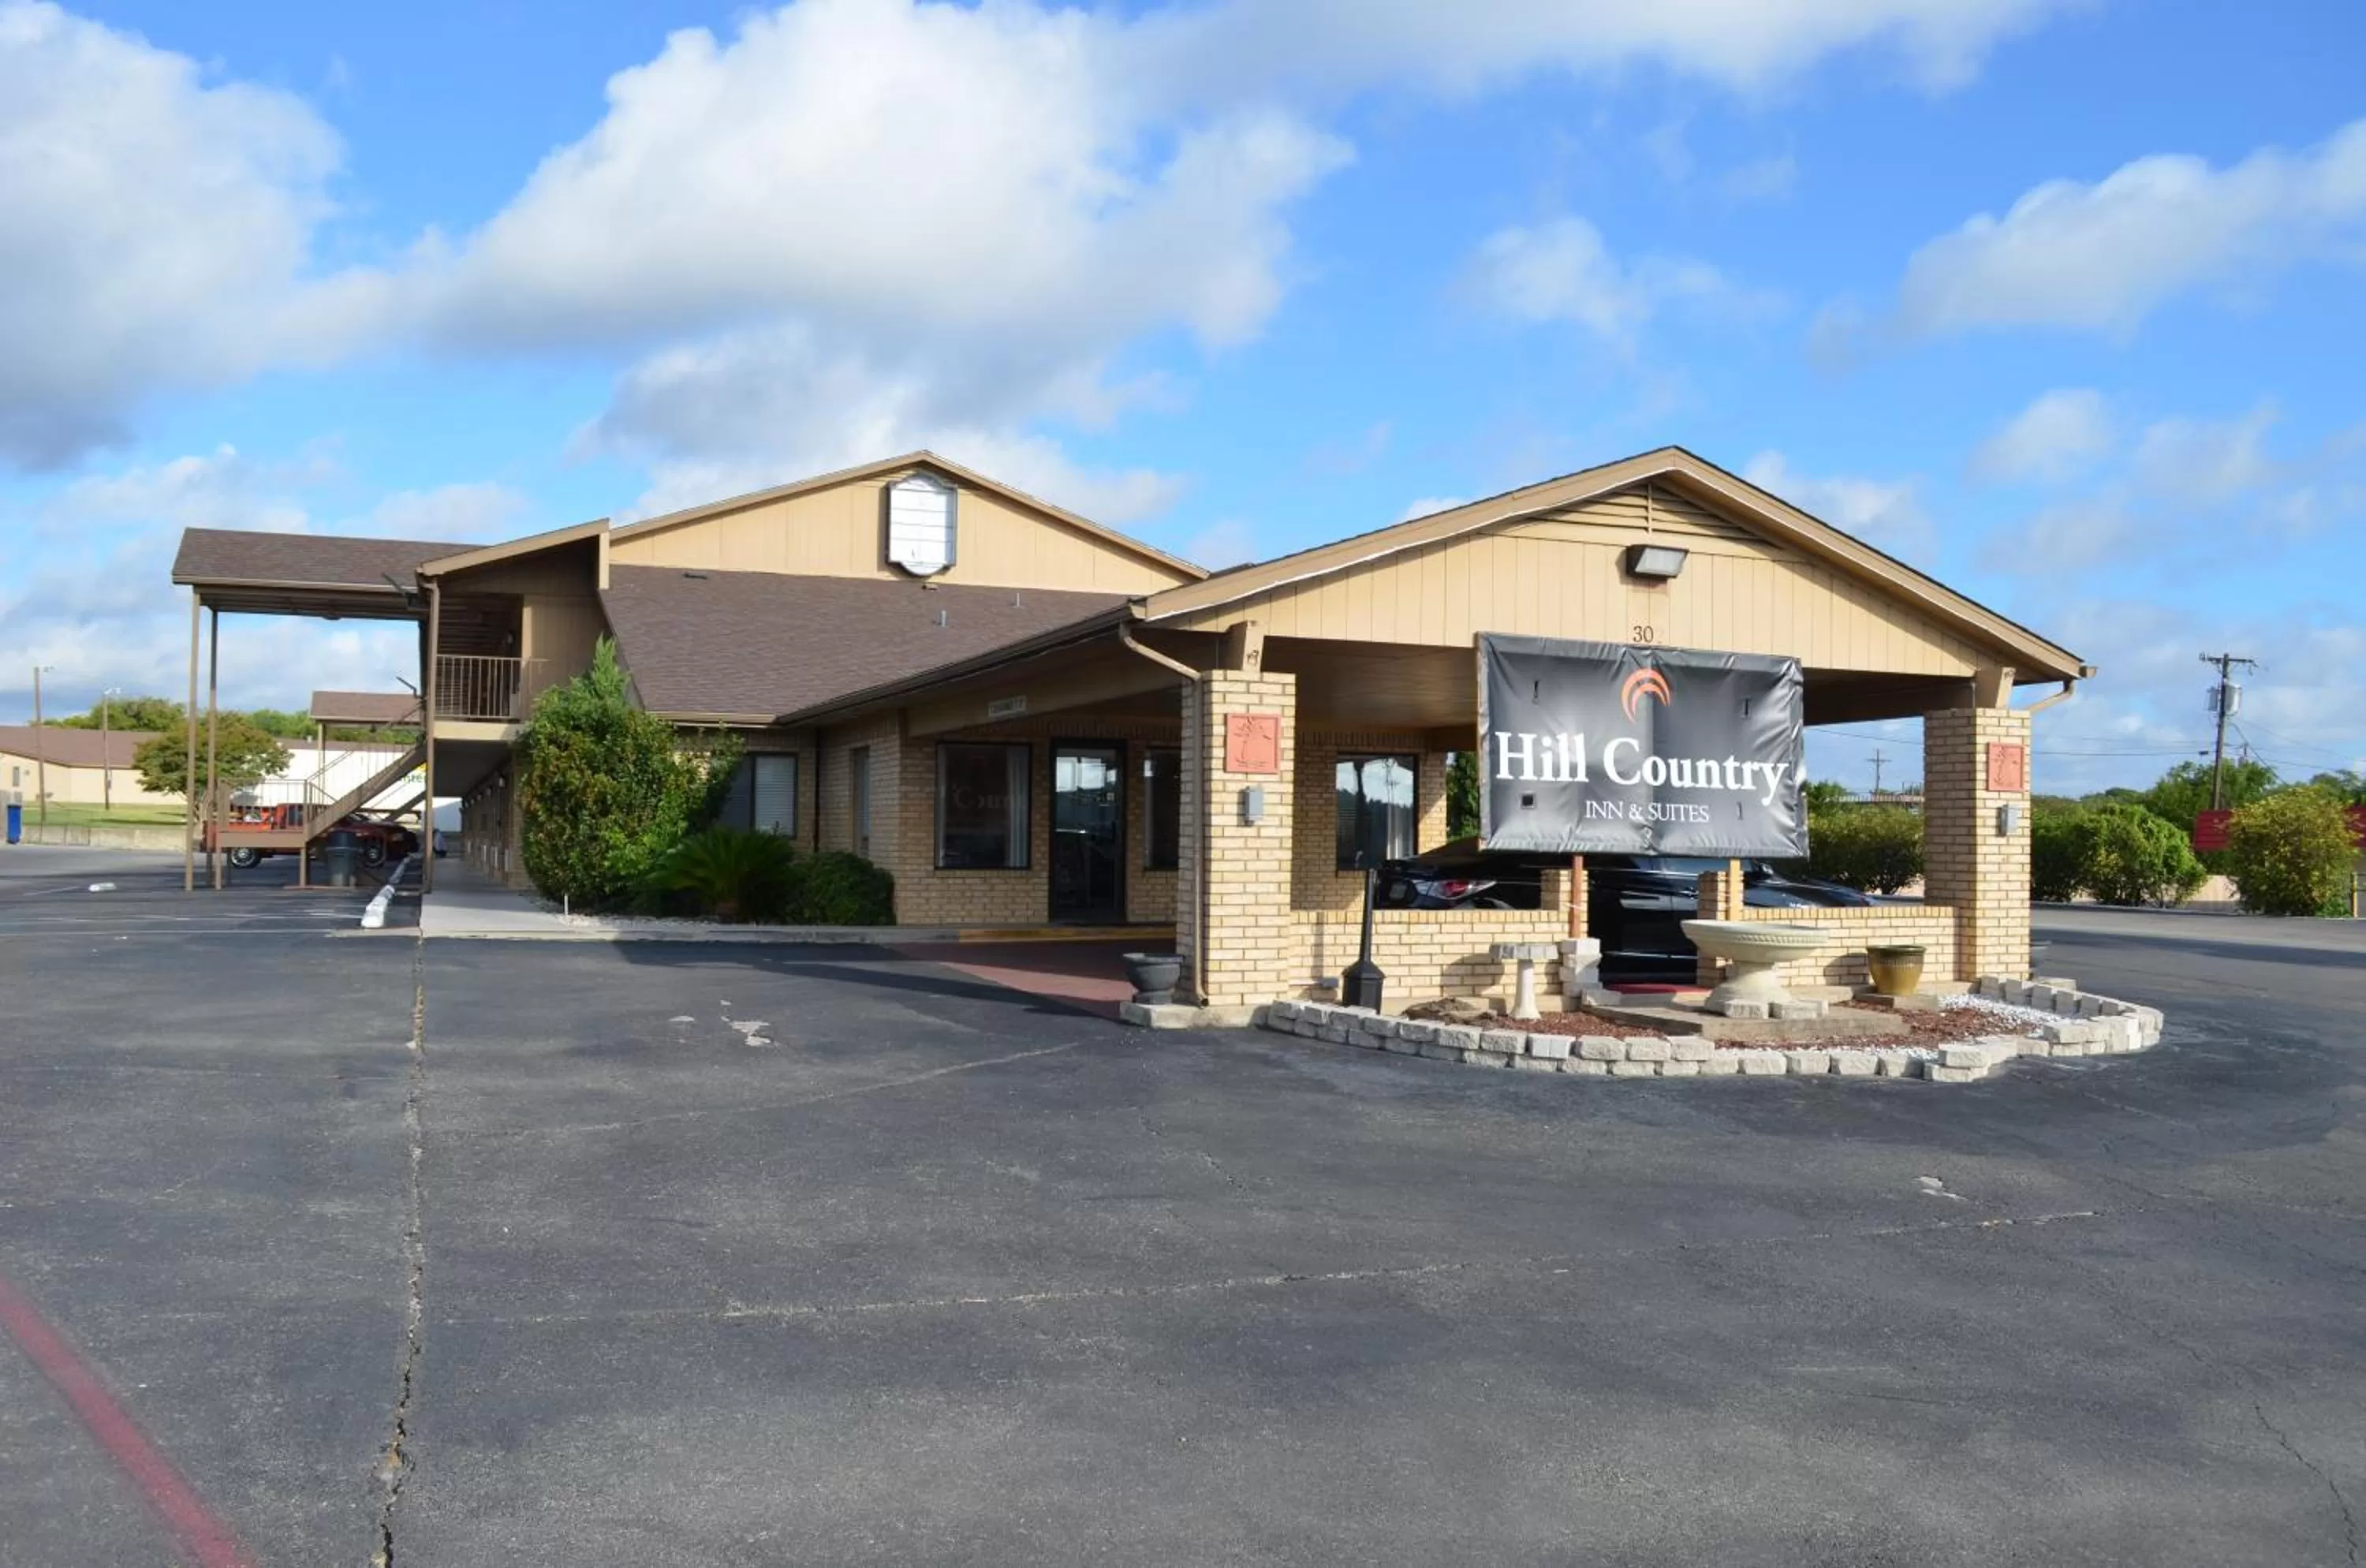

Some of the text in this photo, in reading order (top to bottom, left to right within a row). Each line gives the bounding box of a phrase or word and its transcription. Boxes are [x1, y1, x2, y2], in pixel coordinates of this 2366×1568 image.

[1495, 731, 1789, 806] Hill Country
[1584, 800, 1710, 823] INN & SUITES
